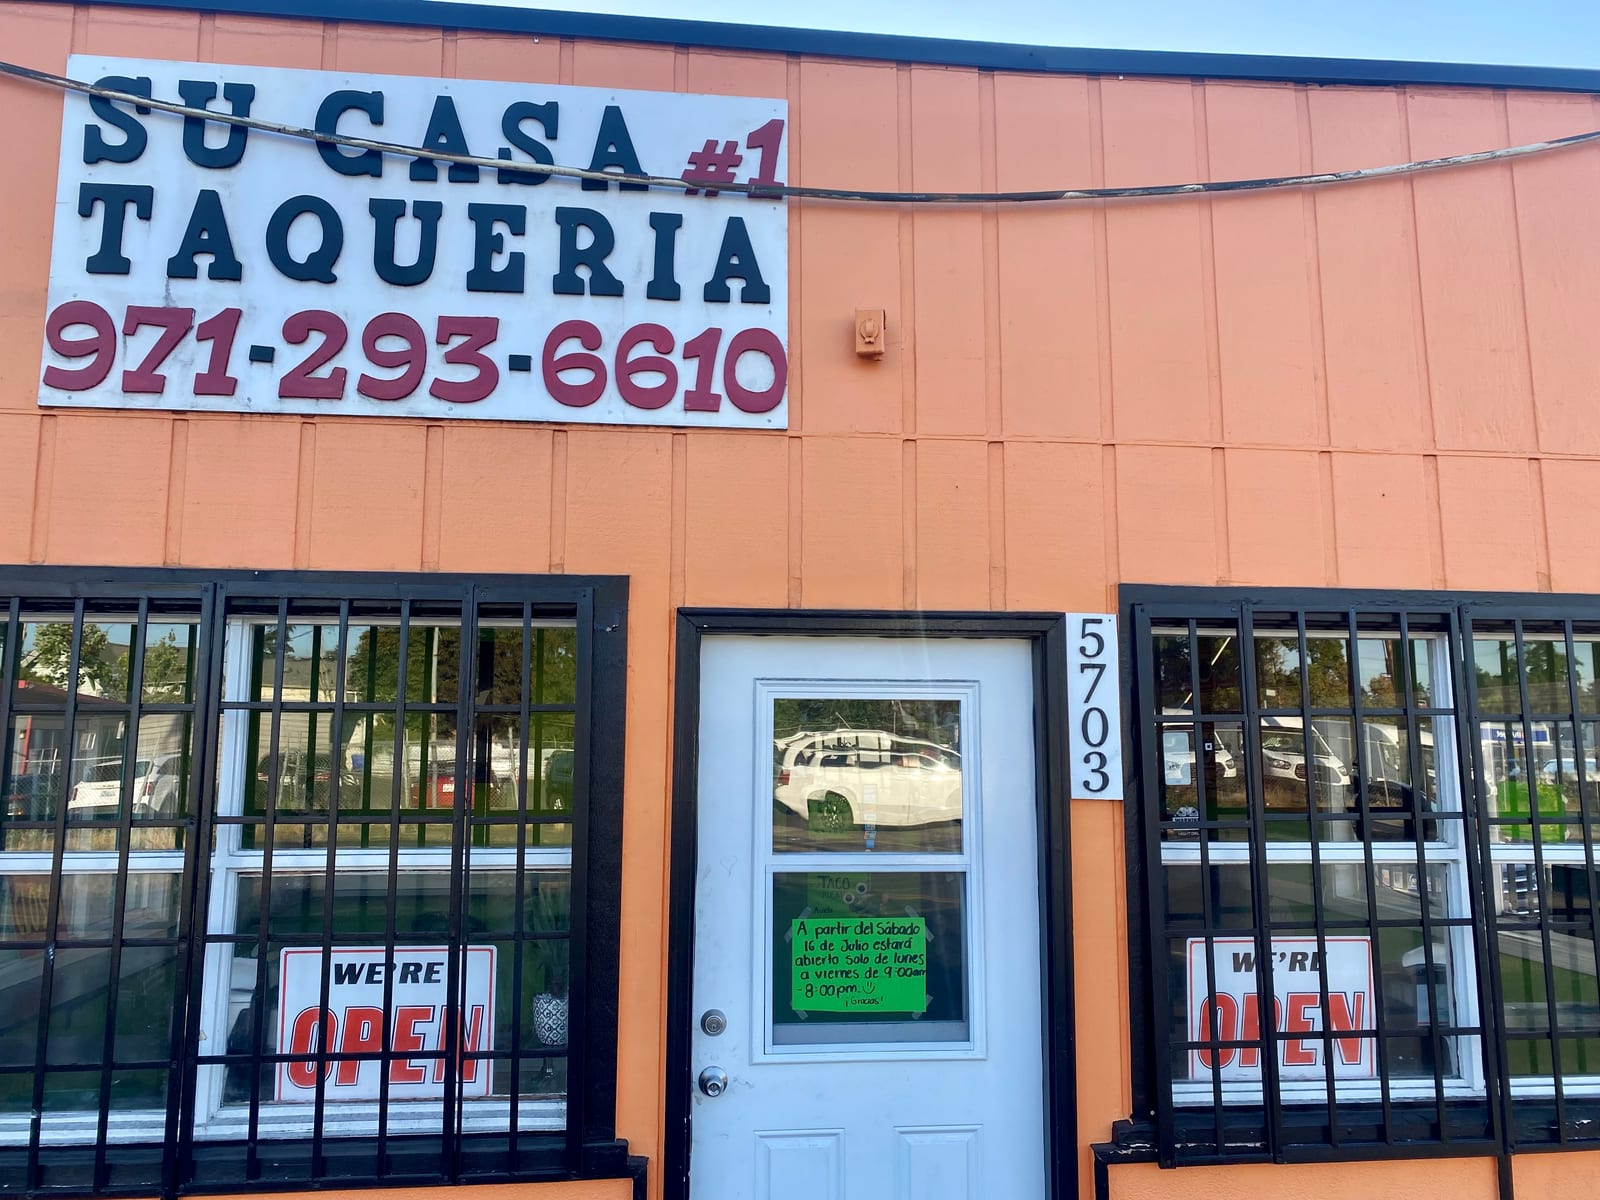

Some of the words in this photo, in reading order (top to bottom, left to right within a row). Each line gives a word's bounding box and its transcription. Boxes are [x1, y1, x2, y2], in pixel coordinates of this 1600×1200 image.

[83, 75, 255, 170] SU
[315, 89, 650, 192] CASA
[681, 119, 787, 199] #1
[78, 182, 771, 304] TAQUERIA
[42, 300, 789, 414] 971-293-6610
[1079, 618, 1110, 793] 5703
[795, 954, 839, 967] abierto
[874, 953, 888, 965] de
[893, 952, 925, 966] lunes
[797, 921, 808, 935] A
[815, 921, 852, 939] partir
[854, 921, 874, 935] del
[876, 921, 921, 935] Sábado
[804, 940, 815, 952] 16
[820, 940, 834, 951] de
[840, 939, 869, 952] Julio
[872, 937, 912, 951] estará
[800, 970, 810, 980] a
[815, 969, 860, 980] viernes
[864, 966, 879, 979] de
[286, 1004, 485, 1090] OPEN
[1198, 991, 1366, 1070] OPEN
